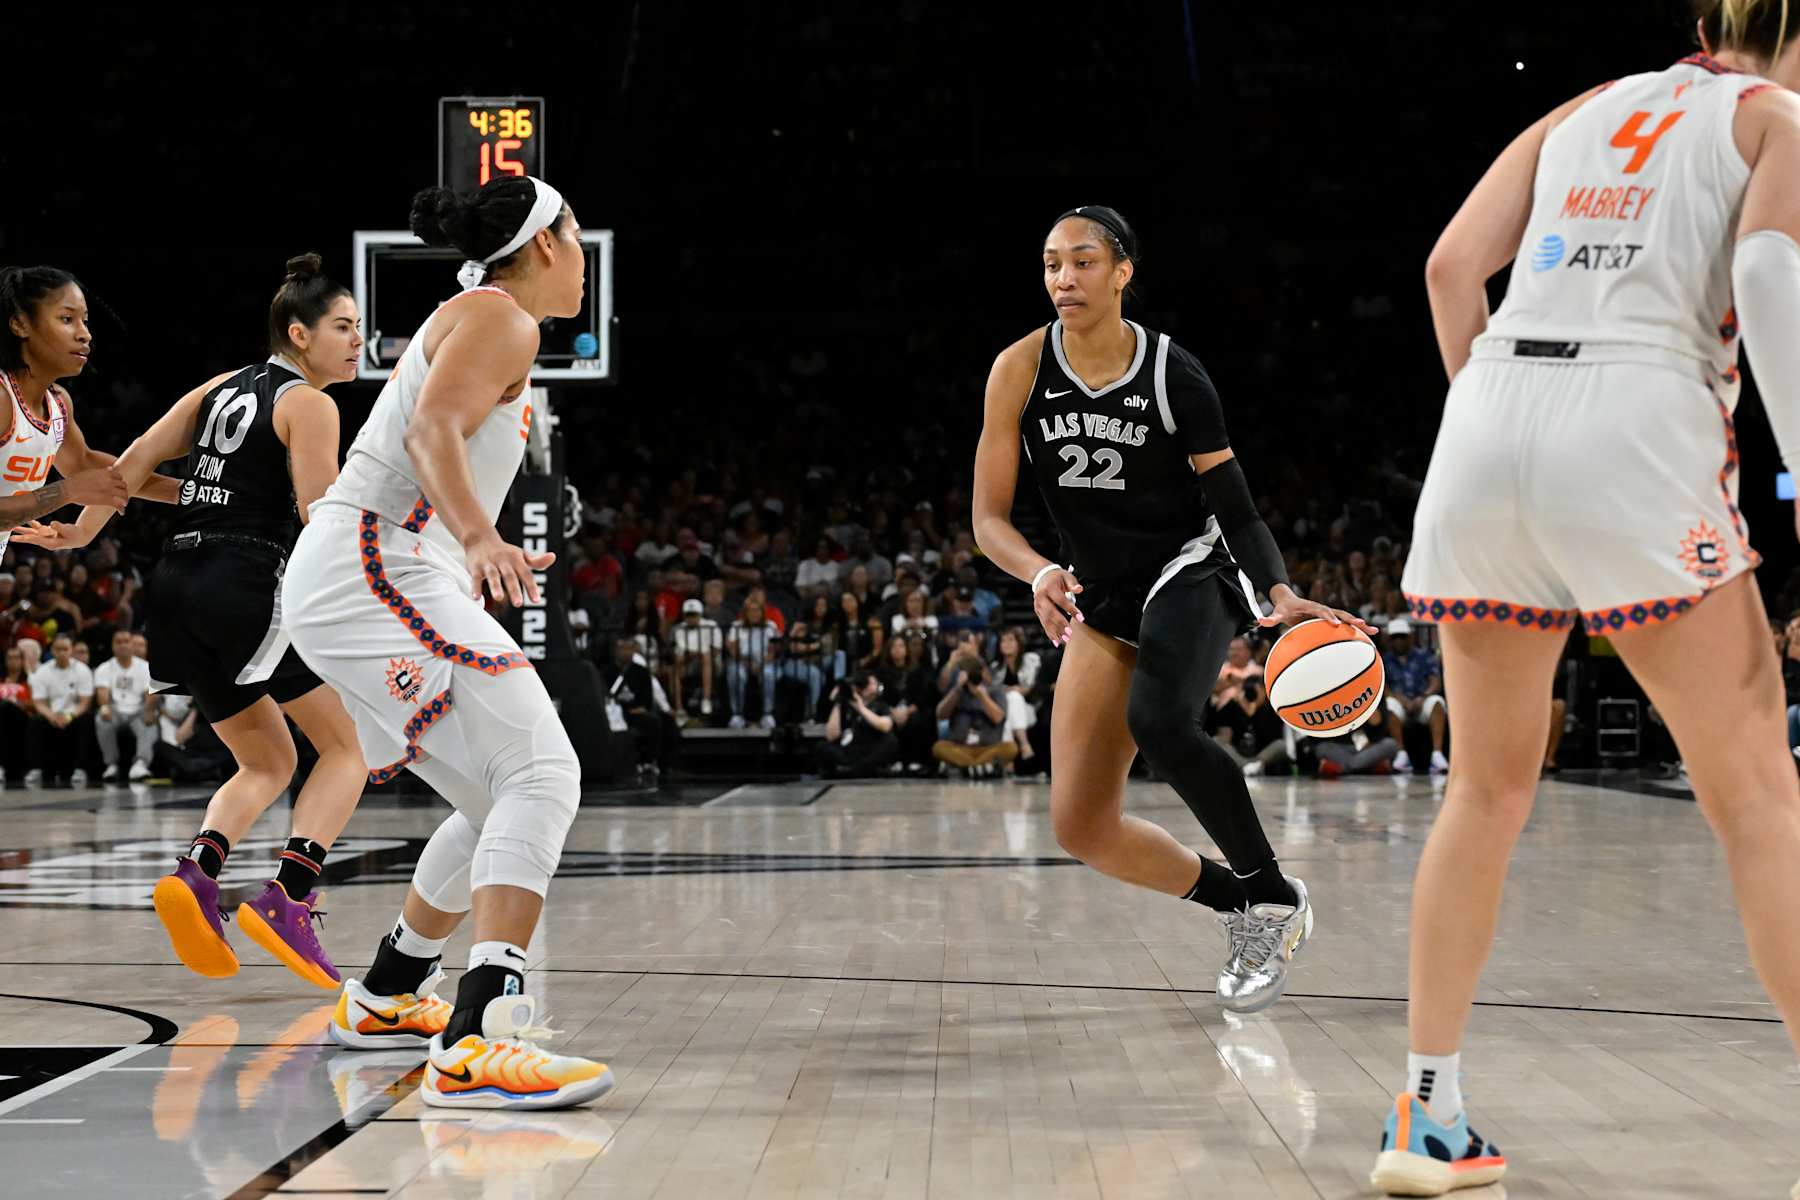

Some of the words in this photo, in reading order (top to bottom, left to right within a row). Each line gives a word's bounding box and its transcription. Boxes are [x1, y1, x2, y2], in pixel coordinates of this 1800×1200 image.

[469, 108, 534, 139] 4:36
[1609, 111, 1686, 174] 4
[479, 139, 524, 186] 15
[1559, 185, 1654, 221] MABREY
[1567, 244, 1643, 270] AT&T
[1123, 395, 1149, 411] ally
[198, 387, 258, 454] 10
[1039, 412, 1081, 442] LAS
[1082, 413, 1149, 446] VEGAS
[3, 455, 55, 482] SU
[195, 454, 226, 481] PLUM
[1057, 444, 1126, 490] 22
[196, 485, 234, 505] AT&T
[1299, 686, 1374, 726] Wilson
